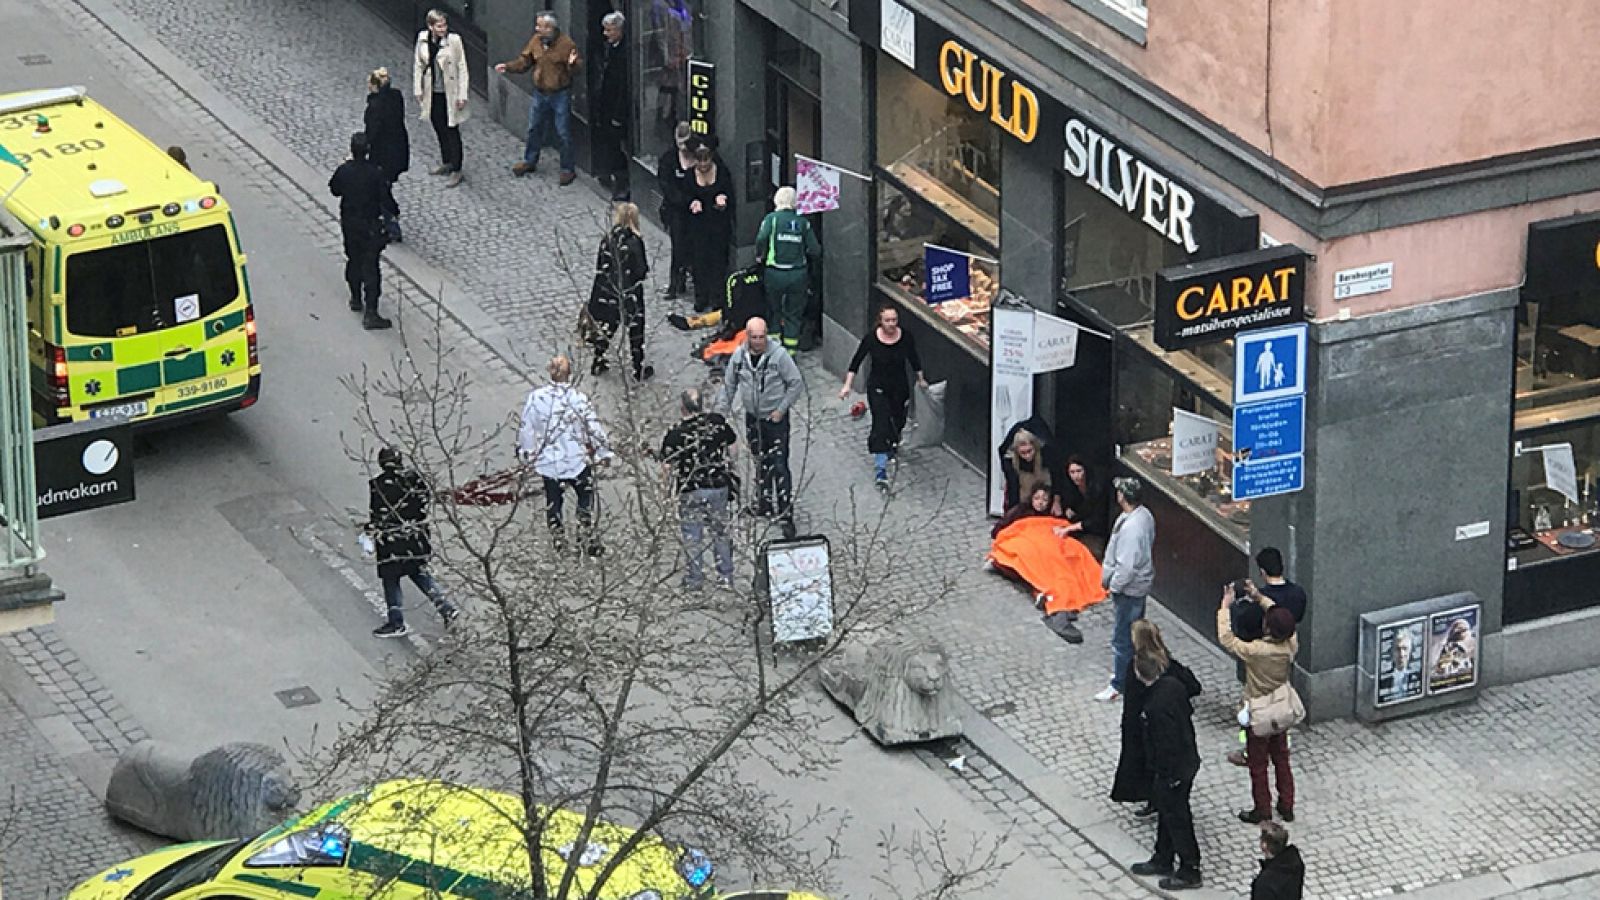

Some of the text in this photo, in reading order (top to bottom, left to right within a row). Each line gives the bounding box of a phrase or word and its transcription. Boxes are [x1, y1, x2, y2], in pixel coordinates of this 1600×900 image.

[939, 40, 1039, 144] GULD
[1064, 118, 1199, 254] SILVER
[110, 221, 180, 245] AMBULANS
[931, 262, 955, 275] SHOP
[931, 274, 948, 283] TAX
[931, 280, 953, 293] FREE
[1176, 267, 1296, 321] CARAT
[1038, 335, 1071, 349] CARAT
[177, 376, 228, 398] 339-9180
[1179, 432, 1213, 449] CARAT
